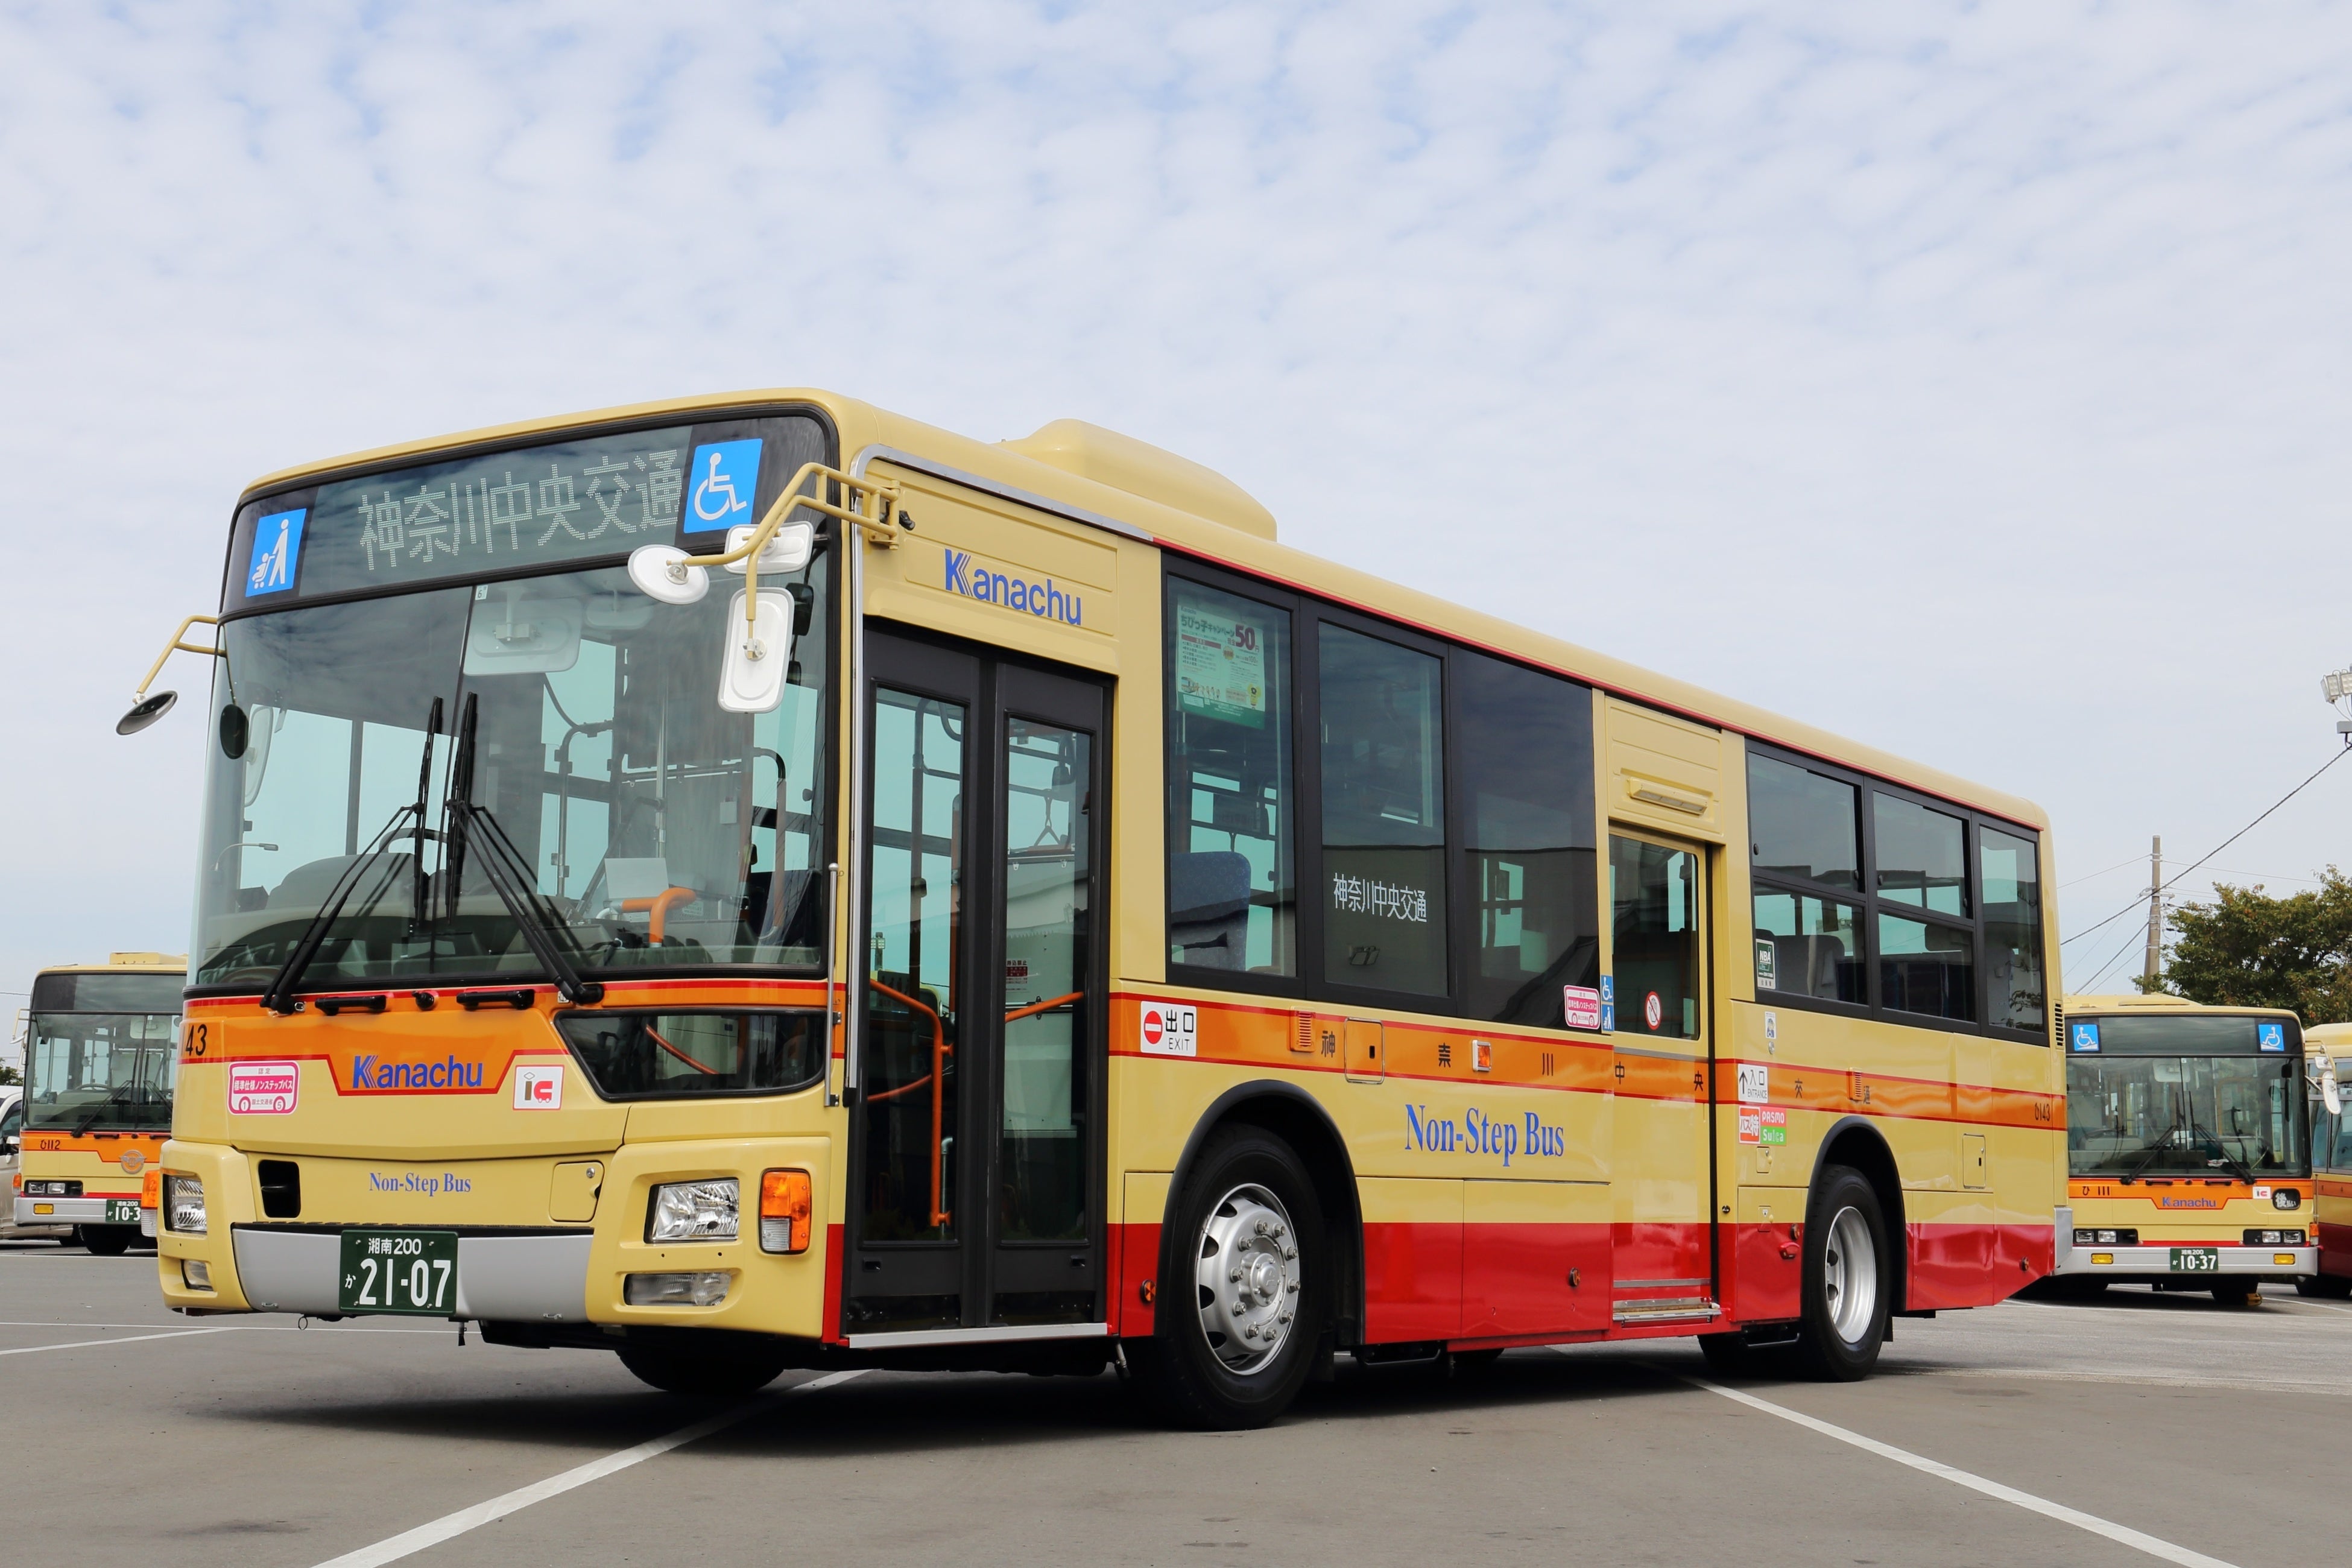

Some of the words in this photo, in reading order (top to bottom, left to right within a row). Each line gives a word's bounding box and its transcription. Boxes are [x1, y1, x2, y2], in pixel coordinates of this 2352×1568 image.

[358, 449, 681, 570] 神奈川中央交通
[944, 548, 1081, 625] Kanachu
[1333, 872, 1427, 923] 神奈川中央交通
[1759, 950, 1771, 963] NBA
[1166, 1009, 1194, 1033] 出口
[183, 1023, 207, 1056] 43
[1169, 1037, 1190, 1051] EXIT
[352, 1055, 483, 1089] Kanachu
[1321, 1030, 1335, 1058] 神
[1438, 1043, 1451, 1068] 奈
[1542, 1052, 1554, 1076] 川
[1615, 1061, 1625, 1084] 中
[1693, 1070, 1703, 1092] 央
[1795, 1078, 1803, 1099] 交
[233, 1080, 293, 1091] 標準仕様ノンステップバス
[1750, 1069, 1765, 1086] 入口
[1747, 1088, 1767, 1099] ENTRANCE
[1762, 1111, 1785, 1124] PASMO
[1405, 1104, 1517, 1167] Non-Step
[1523, 1112, 1565, 1157] Bus
[1763, 1129, 1784, 1142] Suica
[369, 1172, 438, 1197] Non-Step
[443, 1172, 471, 1192] Bus
[2162, 1197, 2216, 1207] Kanachu
[2275, 1192, 2297, 1208] 後払い
[115, 1207, 141, 1221] 10-3
[2180, 1254, 2216, 1270] 10-37
[344, 1274, 356, 1289] か
[359, 1258, 451, 1307] 21-07
